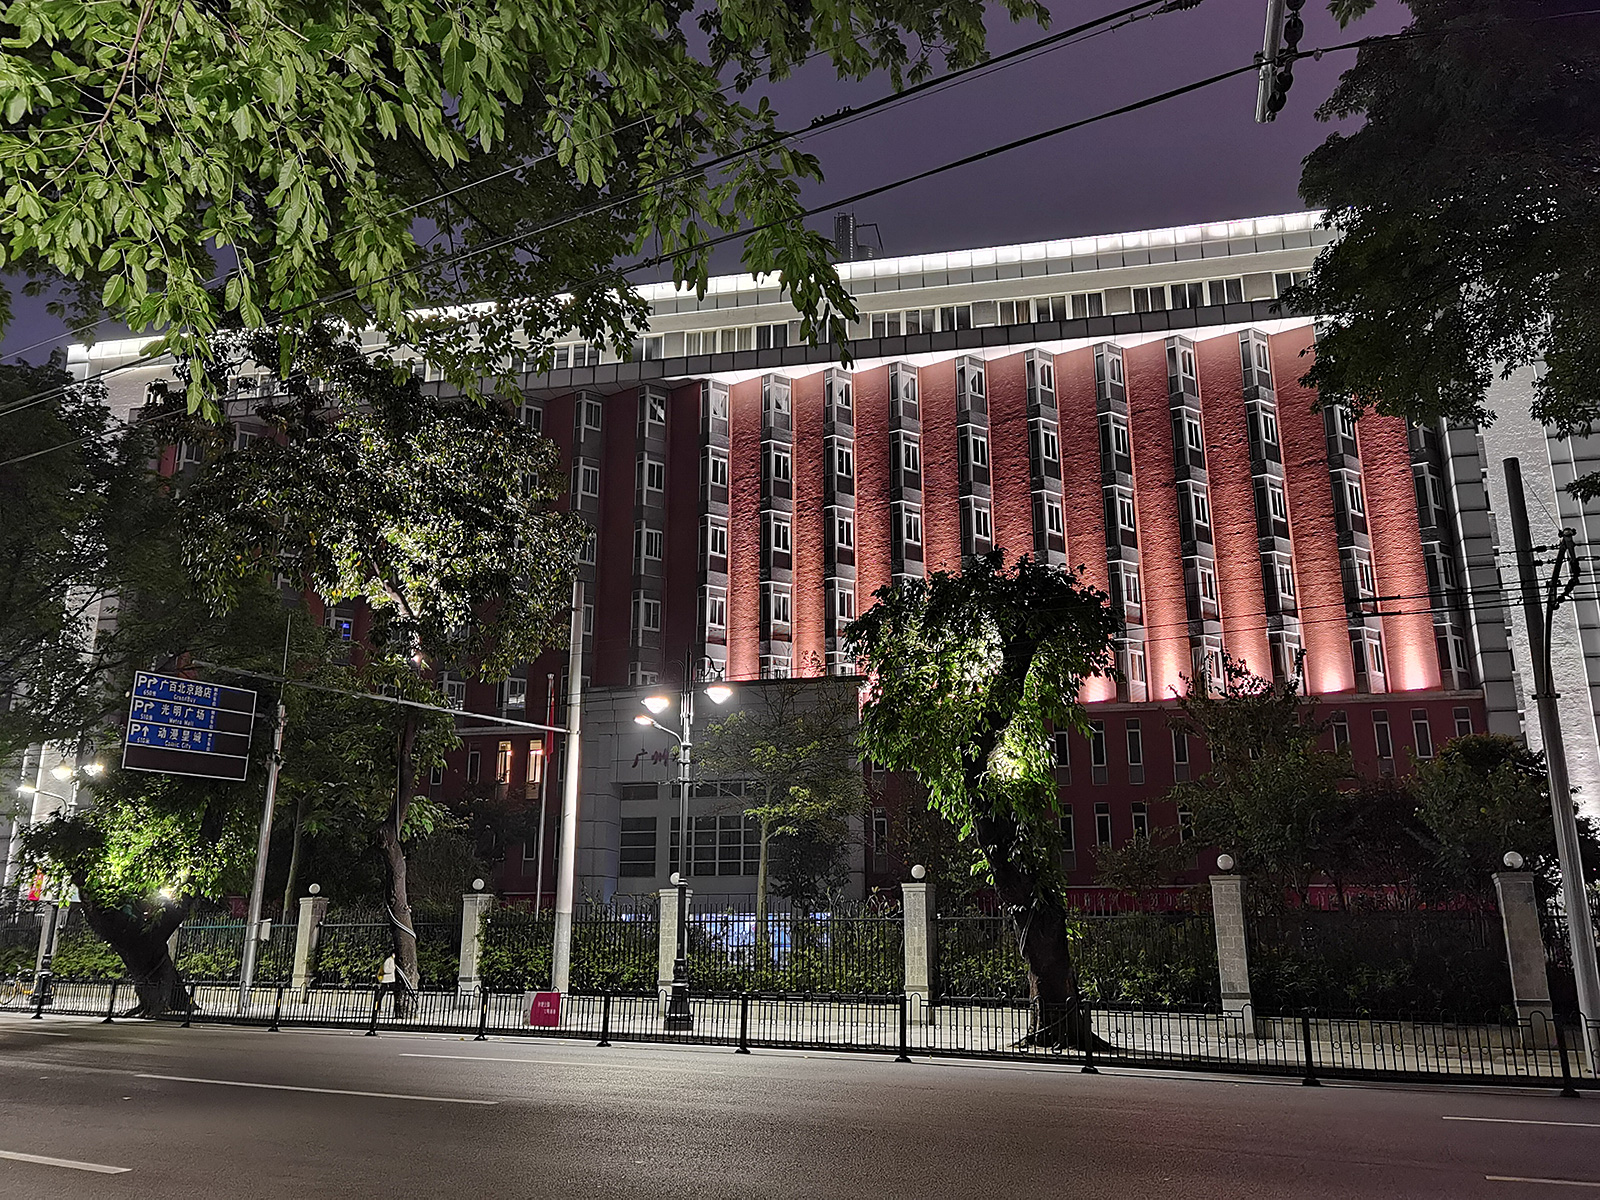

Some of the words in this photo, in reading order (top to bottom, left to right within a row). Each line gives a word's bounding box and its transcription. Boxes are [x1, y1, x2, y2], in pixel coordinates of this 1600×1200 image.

[138, 675, 147, 687] P
[159, 680, 212, 699] 广百北京路店
[134, 699, 144, 711] P
[161, 703, 205, 720] 光明广场
[130, 723, 141, 735] P
[158, 727, 202, 743] 动漫星城
